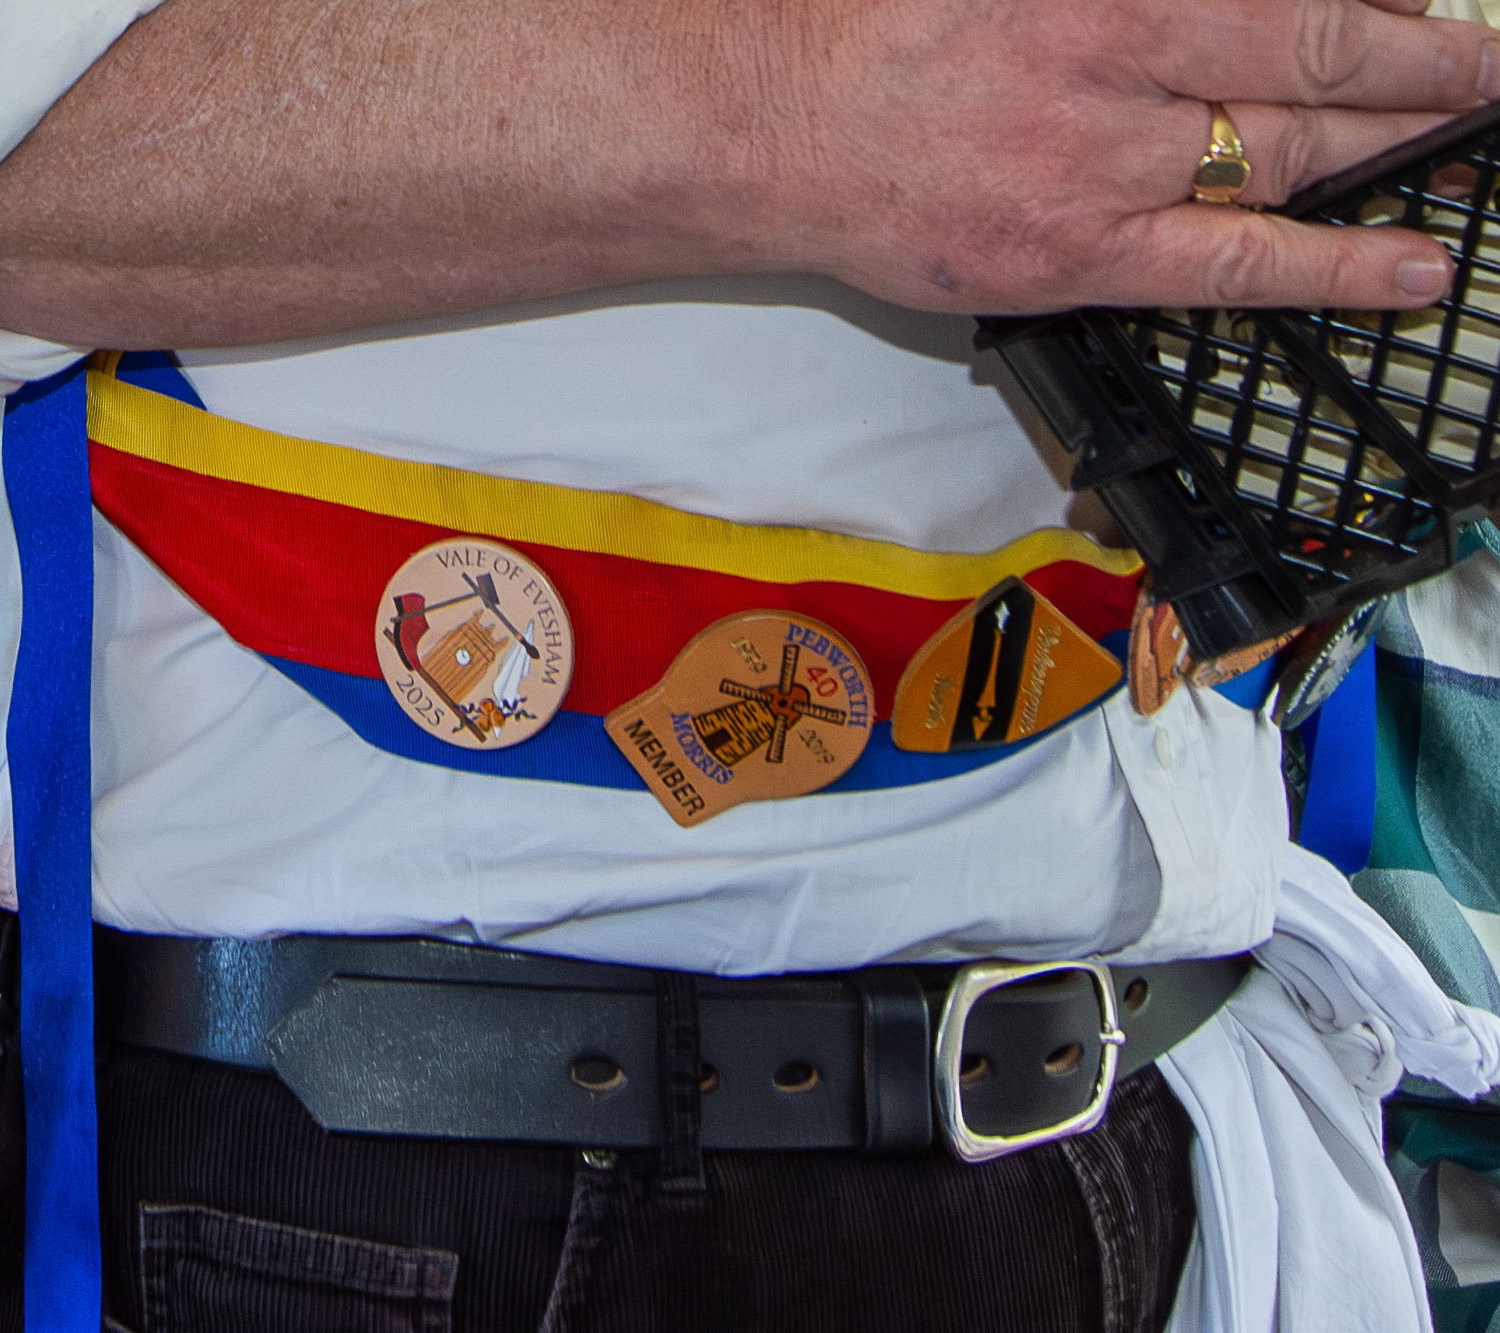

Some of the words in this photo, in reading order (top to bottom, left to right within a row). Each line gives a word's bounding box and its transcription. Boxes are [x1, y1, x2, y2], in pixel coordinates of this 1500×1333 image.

[435, 548, 487, 568] VALE
[493, 556, 525, 580] OF
[522, 579, 562, 685] EVESHAM
[395, 674, 446, 727] 2025
[785, 622, 869, 729] PEBWORTH
[806, 666, 839, 698] 40
[623, 719, 706, 817] MEMBER
[670, 712, 735, 785] MORRIS
